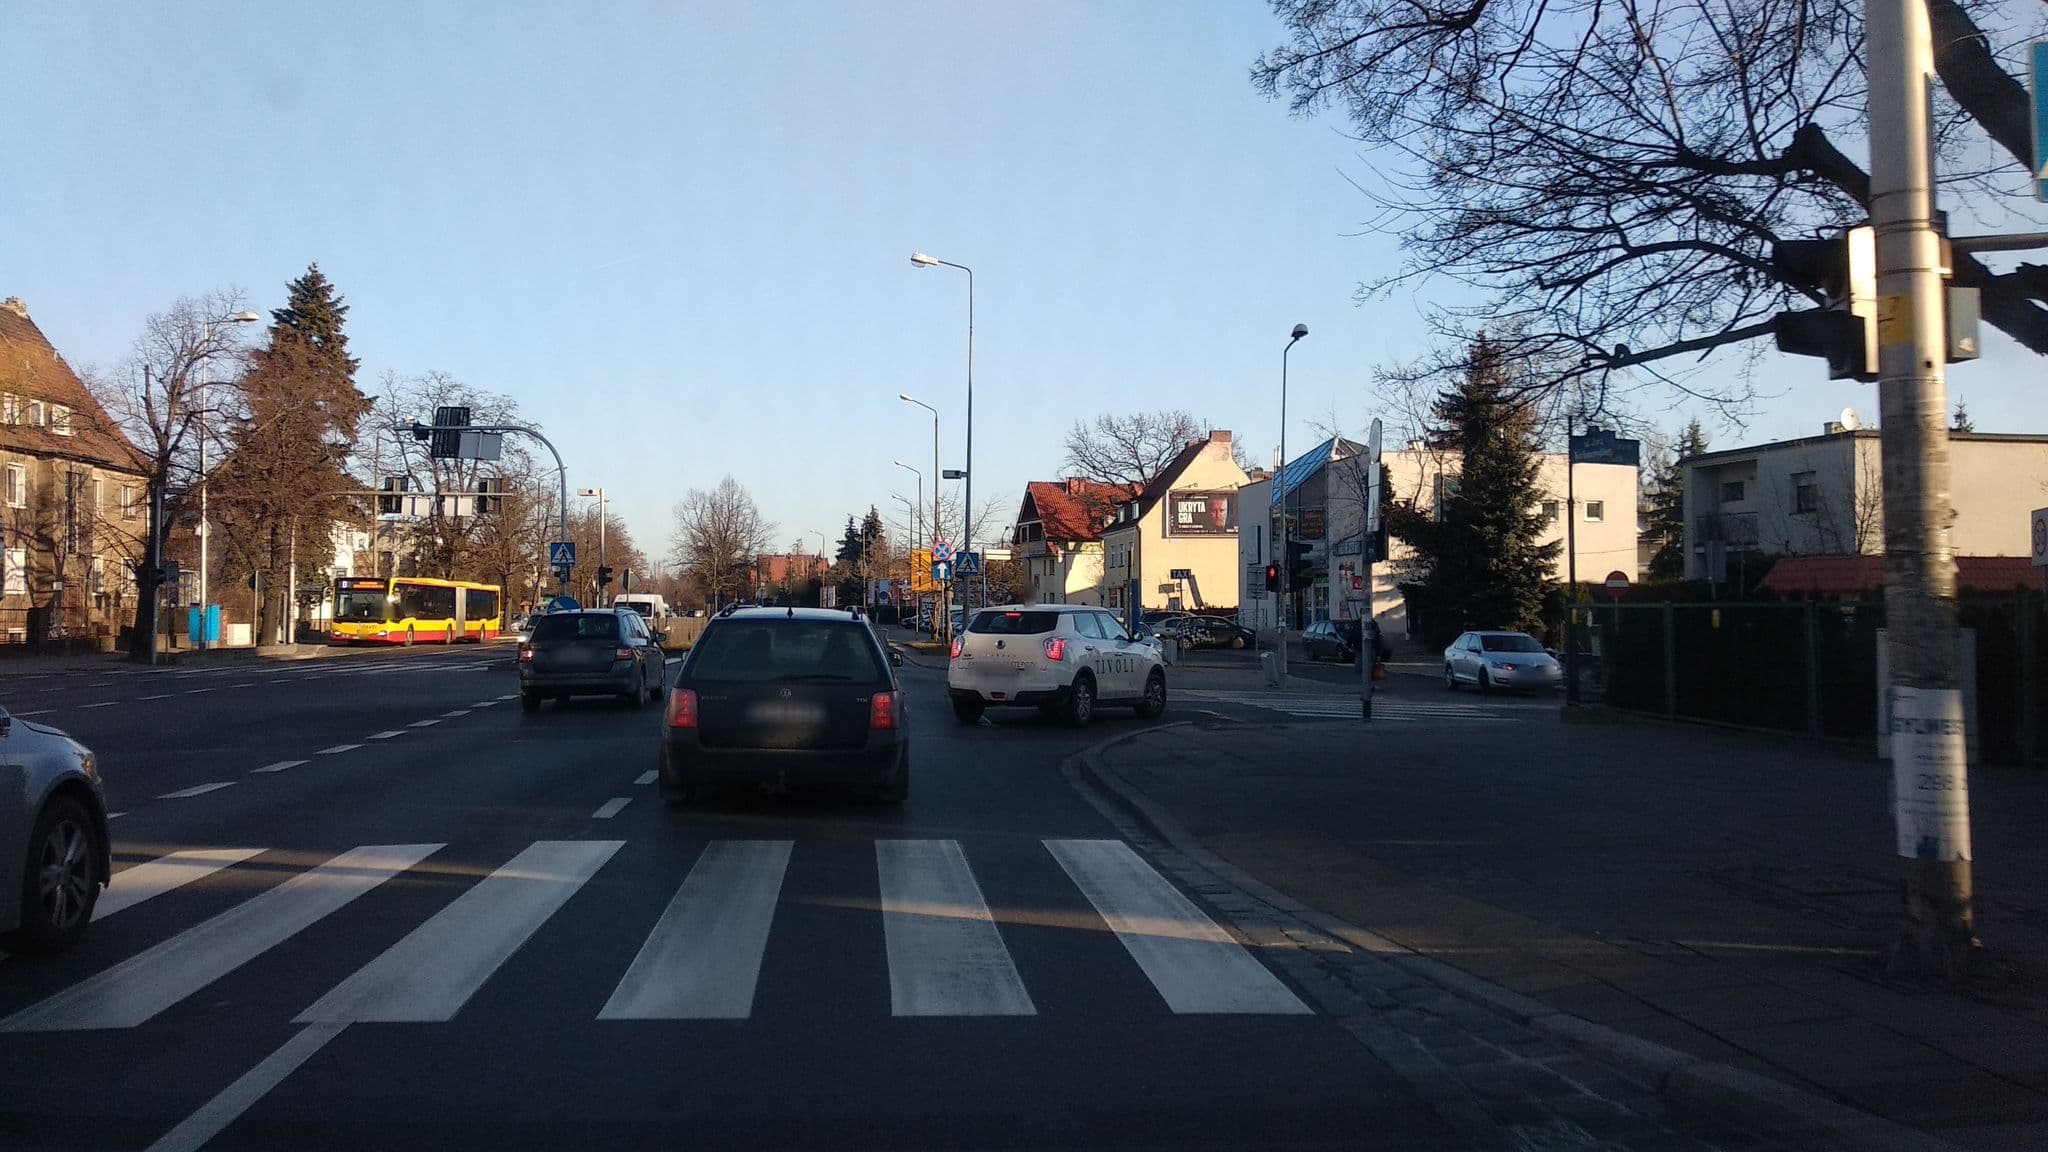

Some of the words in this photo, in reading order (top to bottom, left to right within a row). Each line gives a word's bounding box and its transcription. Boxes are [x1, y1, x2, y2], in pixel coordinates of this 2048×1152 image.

[1178, 502, 1206, 512] UKRYTA
[1178, 513, 1193, 523] GRA
[1173, 571, 1191, 579] TAXI
[1095, 658, 1134, 674] TIVOLI
